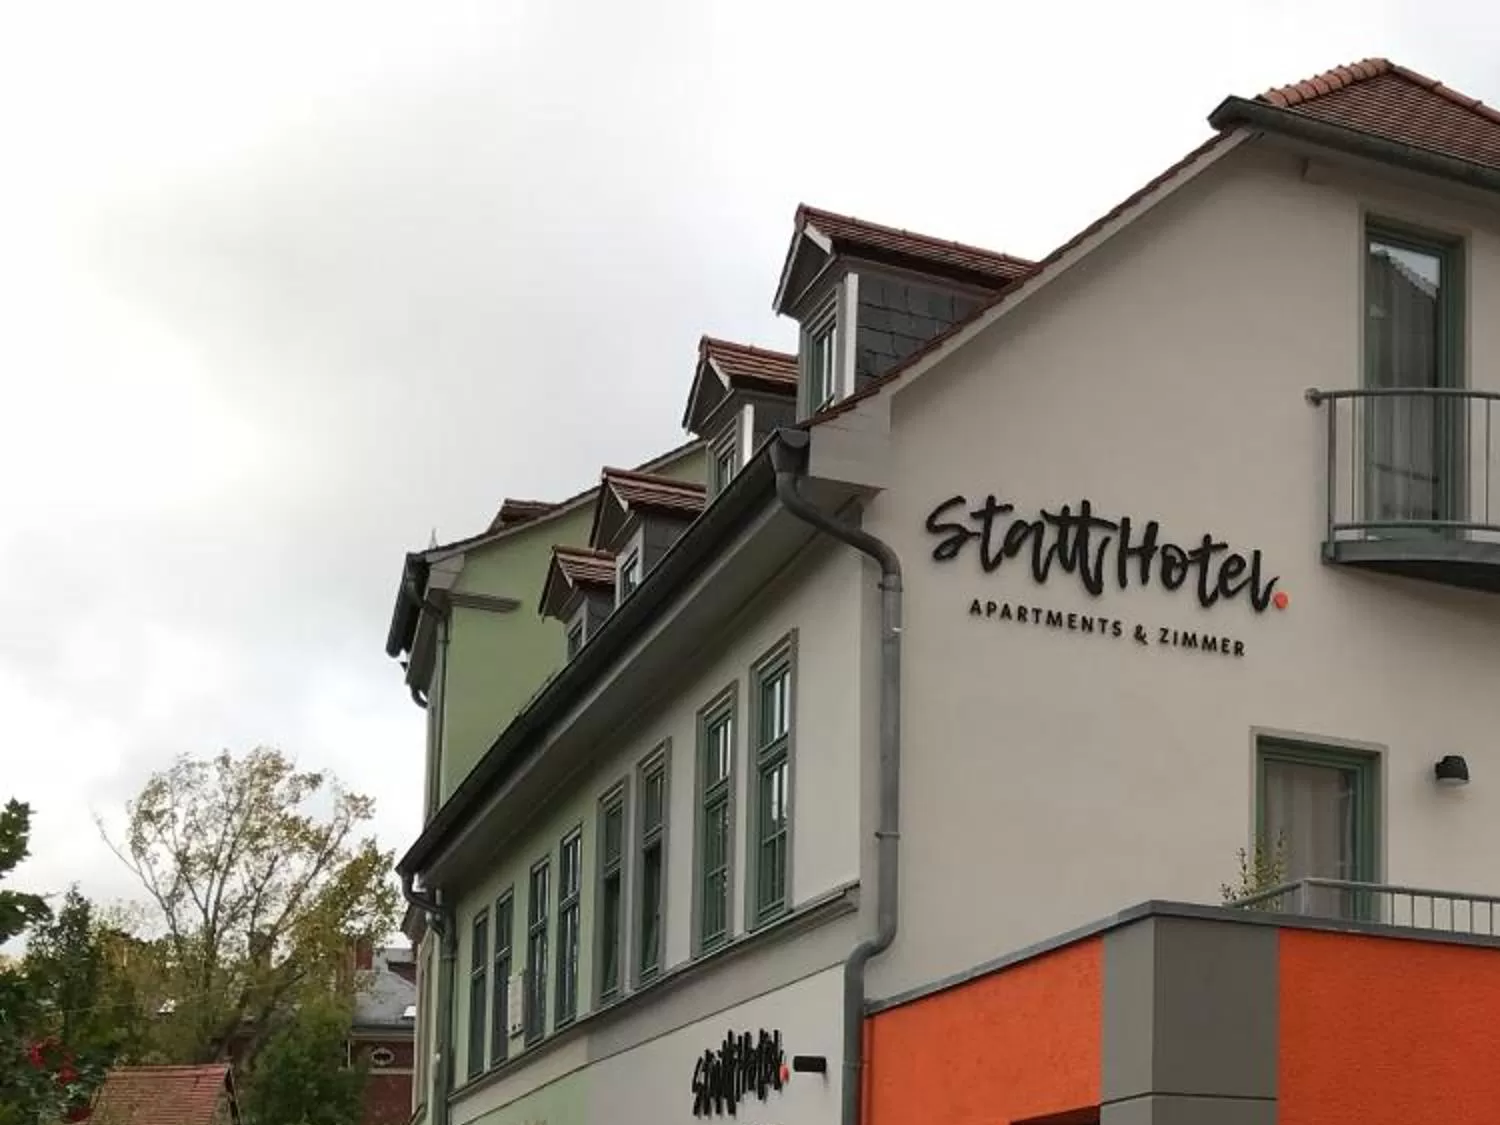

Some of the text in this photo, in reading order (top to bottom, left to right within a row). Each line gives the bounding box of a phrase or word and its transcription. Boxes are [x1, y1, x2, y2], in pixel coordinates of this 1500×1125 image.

[969, 598, 1246, 657] APARTMENTS & ZIMMER
